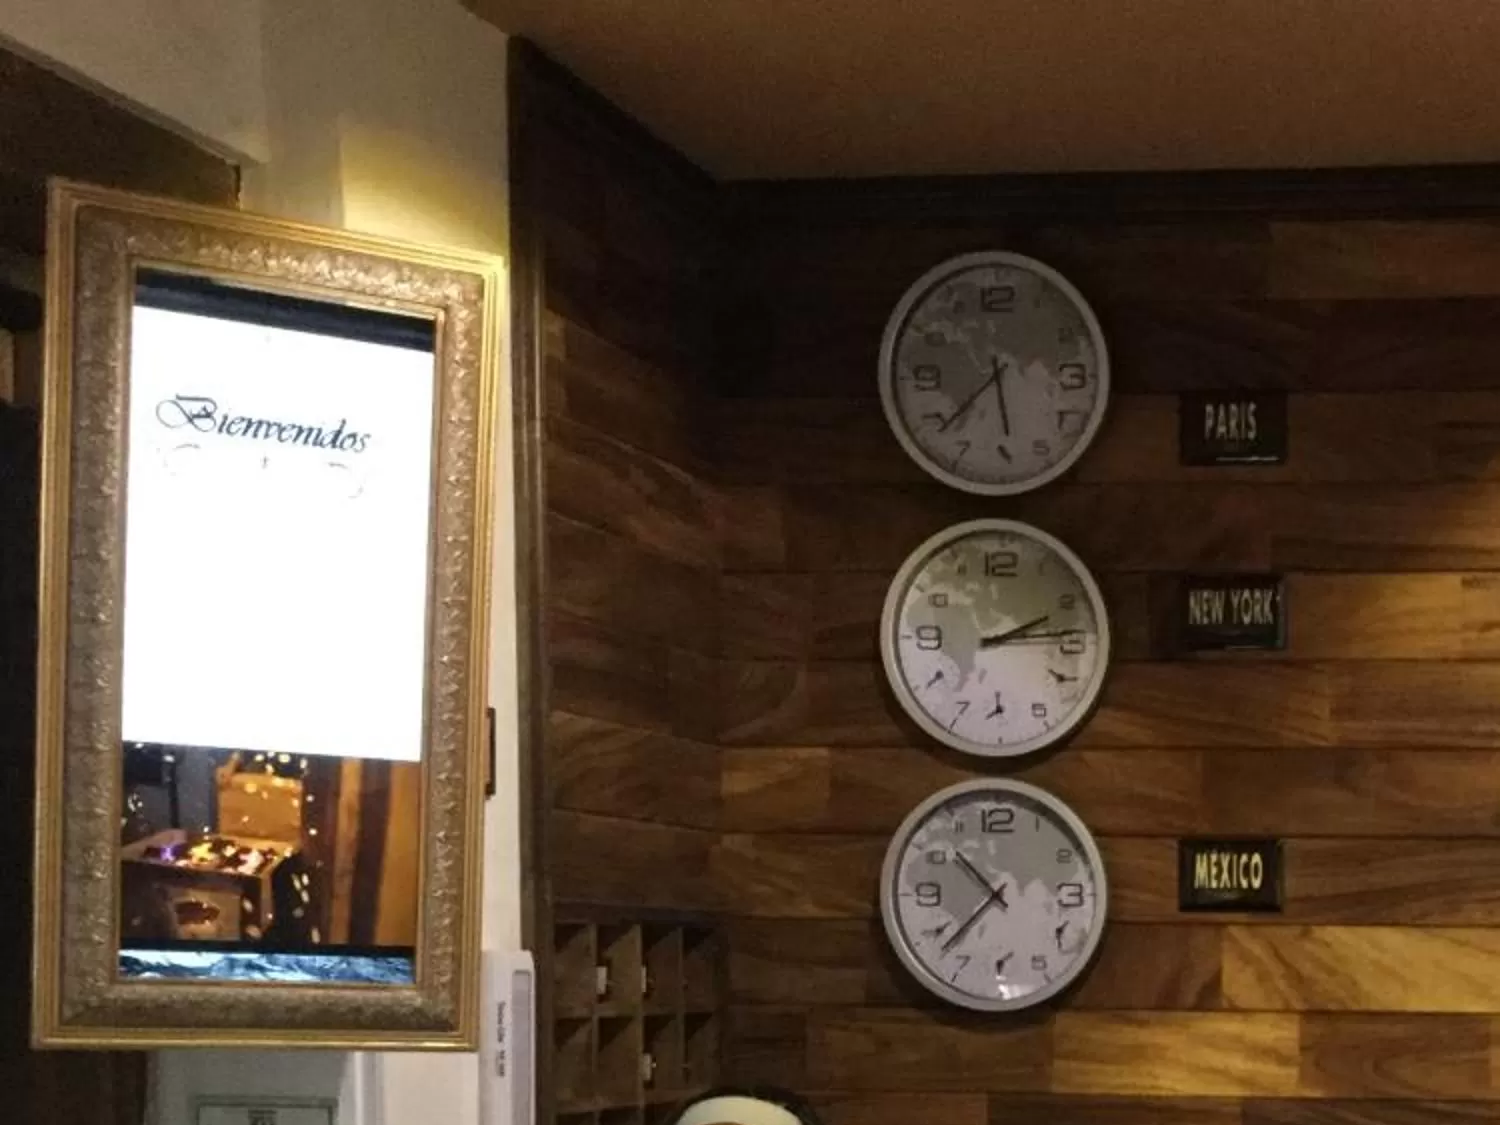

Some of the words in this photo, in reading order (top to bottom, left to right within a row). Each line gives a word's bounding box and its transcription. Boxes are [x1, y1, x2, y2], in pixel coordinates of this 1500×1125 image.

[981, 286, 1015, 312] 12
[913, 364, 941, 391] 9
[1059, 363, 1086, 390] 3
[156, 394, 372, 453] Bienvenidos
[1204, 402, 1257, 440] PARIS
[984, 551, 1018, 577] 12
[1189, 590, 1224, 625] NEW
[1230, 590, 1273, 625] YORK
[916, 625, 942, 650] 9
[981, 808, 1015, 832] 12
[916, 882, 941, 907] 9
[1057, 882, 1084, 907] 3
